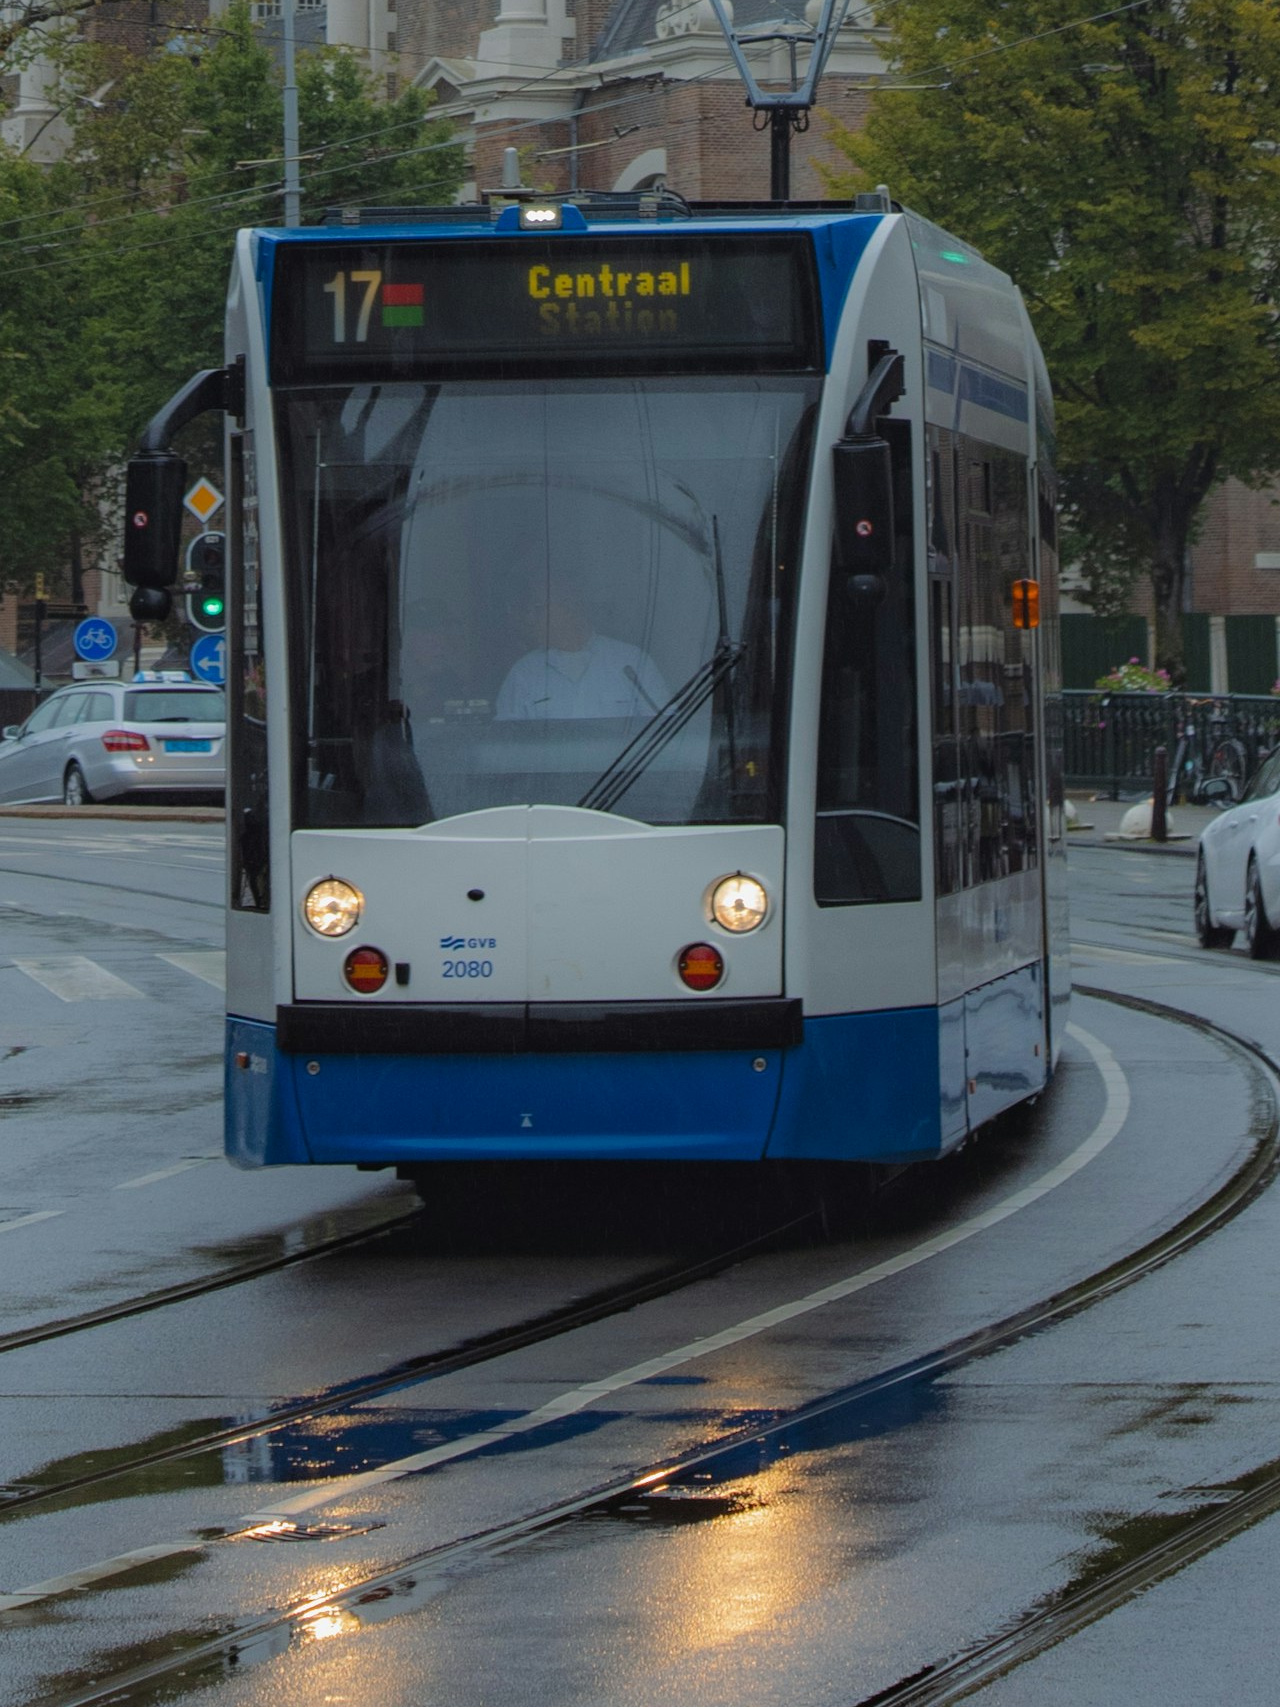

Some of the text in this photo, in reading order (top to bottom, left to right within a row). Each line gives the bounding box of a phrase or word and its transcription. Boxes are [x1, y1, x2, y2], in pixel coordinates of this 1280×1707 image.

[527, 262, 689, 298] Centraal
[323, 270, 382, 341] 17
[538, 299, 677, 334] Station
[467, 937, 497, 949] GVB
[441, 960, 493, 978] 2080
